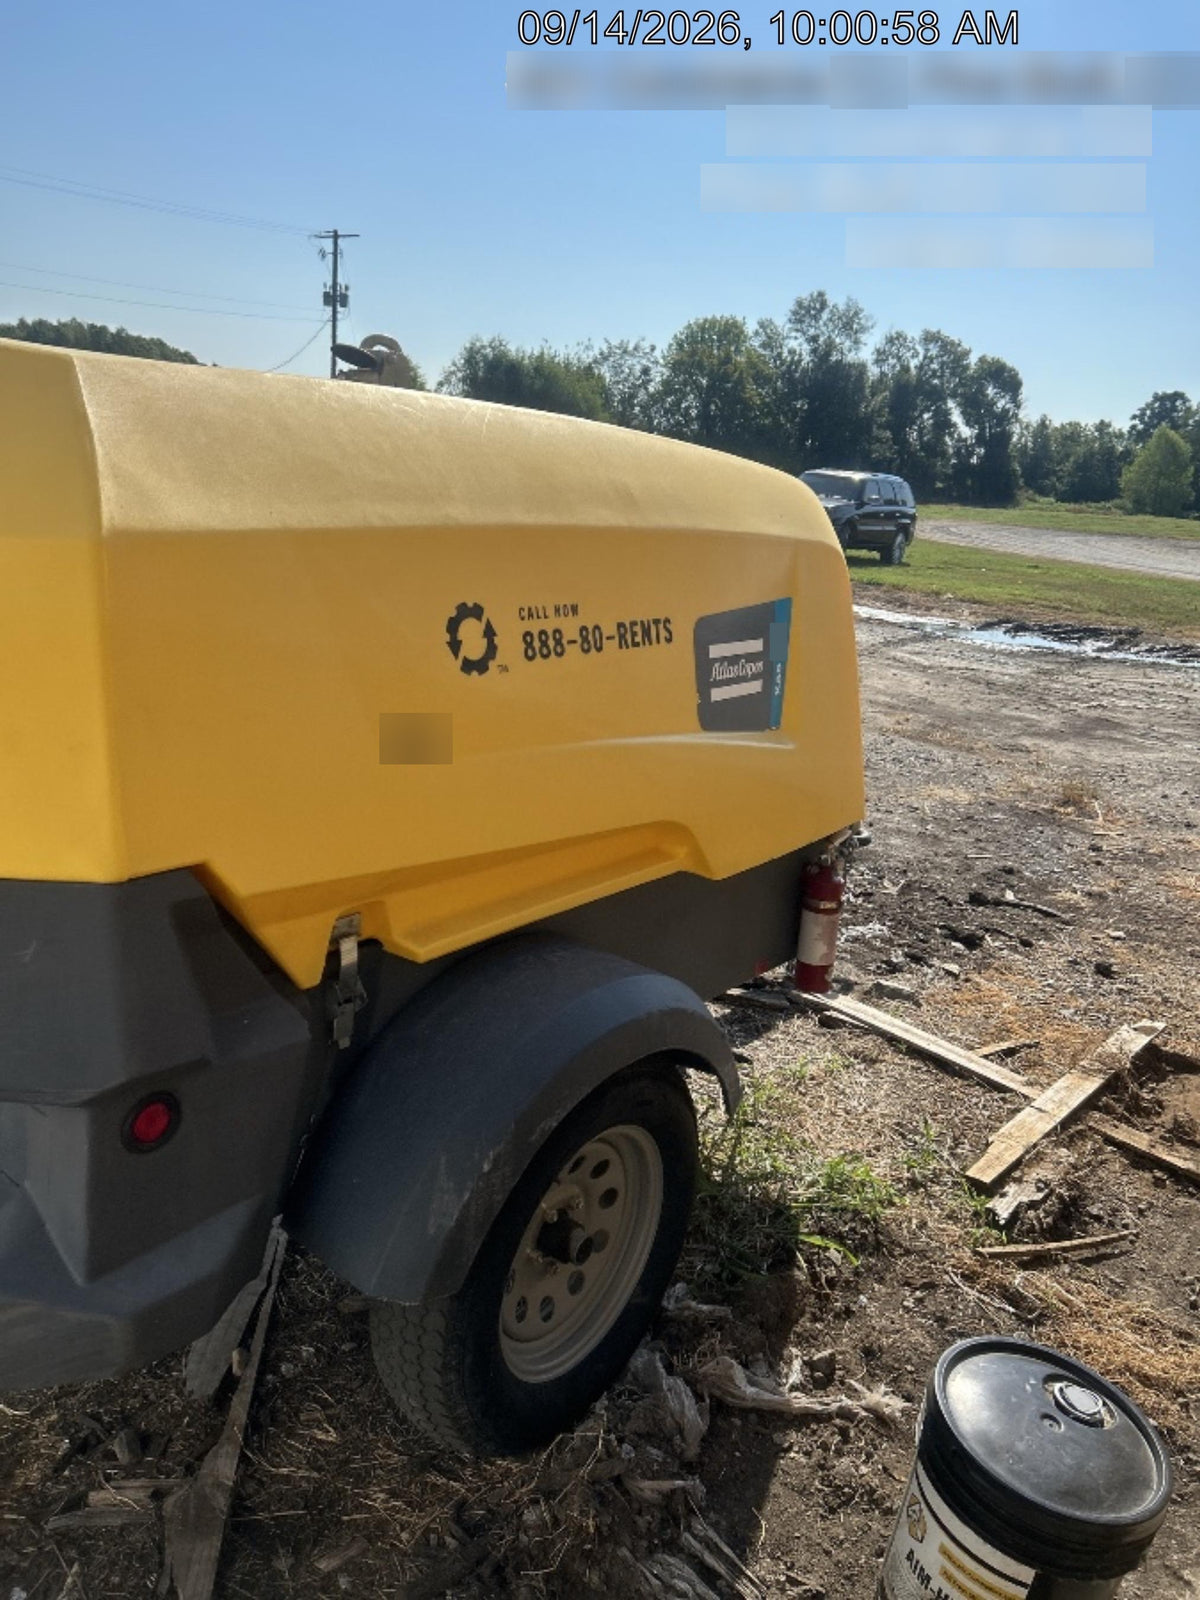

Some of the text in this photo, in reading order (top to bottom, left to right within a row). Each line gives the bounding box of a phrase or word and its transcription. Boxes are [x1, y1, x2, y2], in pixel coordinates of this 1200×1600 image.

[518, 604, 579, 621] CALL NOW
[522, 617, 673, 662] 888-80-RENTS
